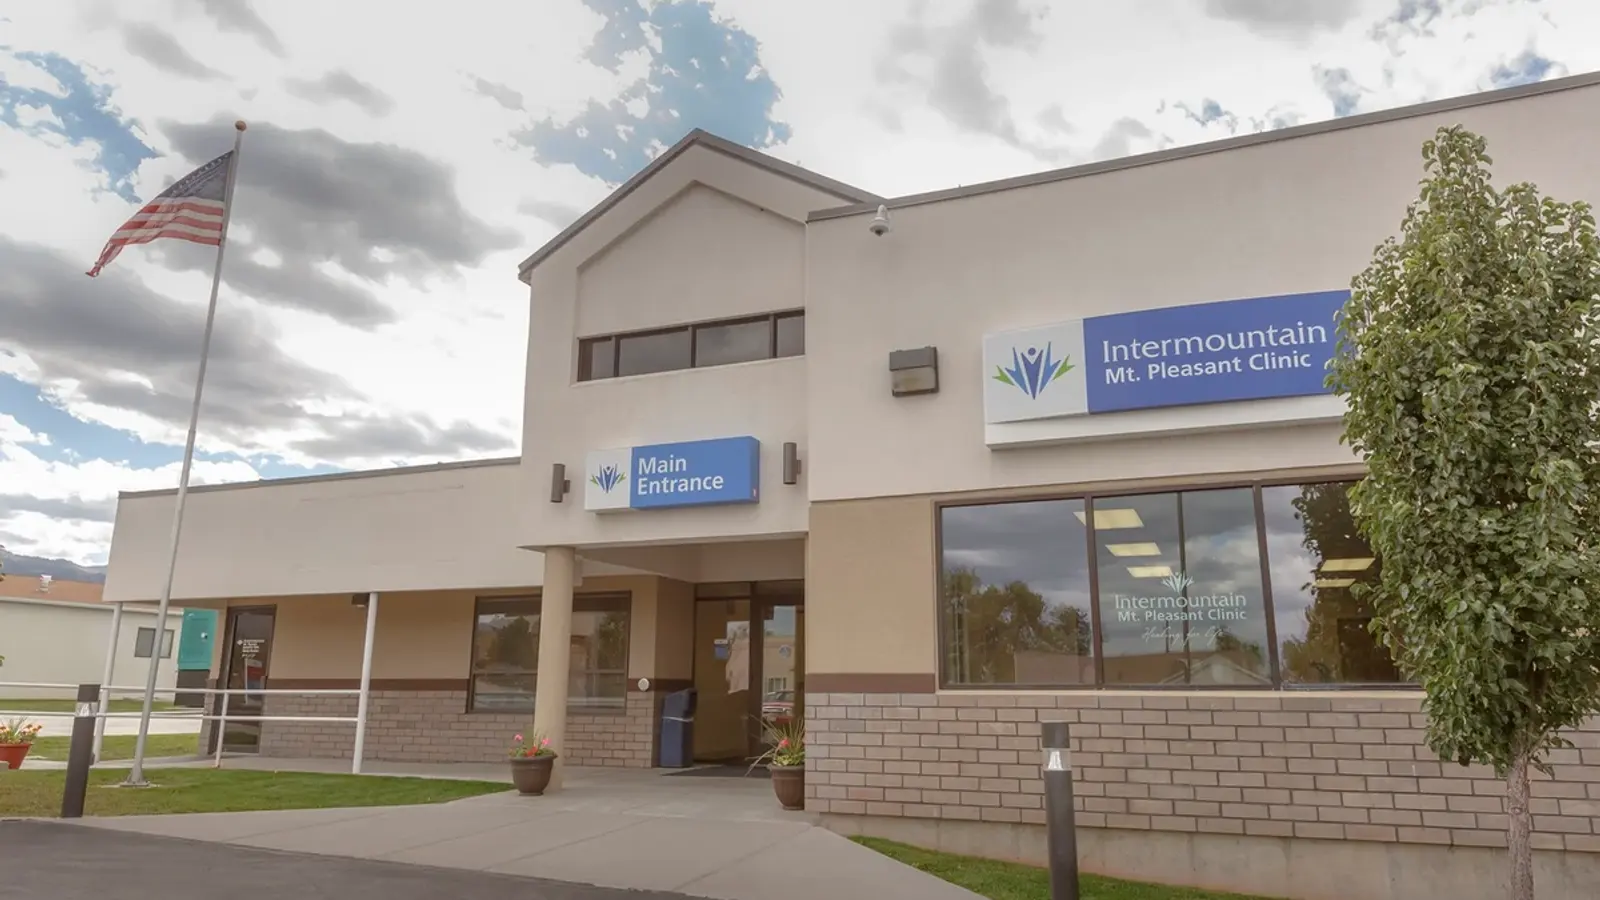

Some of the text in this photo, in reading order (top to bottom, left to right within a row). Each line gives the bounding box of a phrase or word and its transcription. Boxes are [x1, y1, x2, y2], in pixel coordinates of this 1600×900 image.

[1102, 321, 1327, 364] Intermountain
[1105, 350, 1312, 385] Mt. Pleasant Clinic
[638, 454, 687, 475] Main
[637, 475, 724, 495] Entrance
[1115, 592, 1247, 609] Intermountain
[1118, 608, 1247, 622] Mt. Pleasant Clinic
[1141, 626, 1181, 646] Healing
